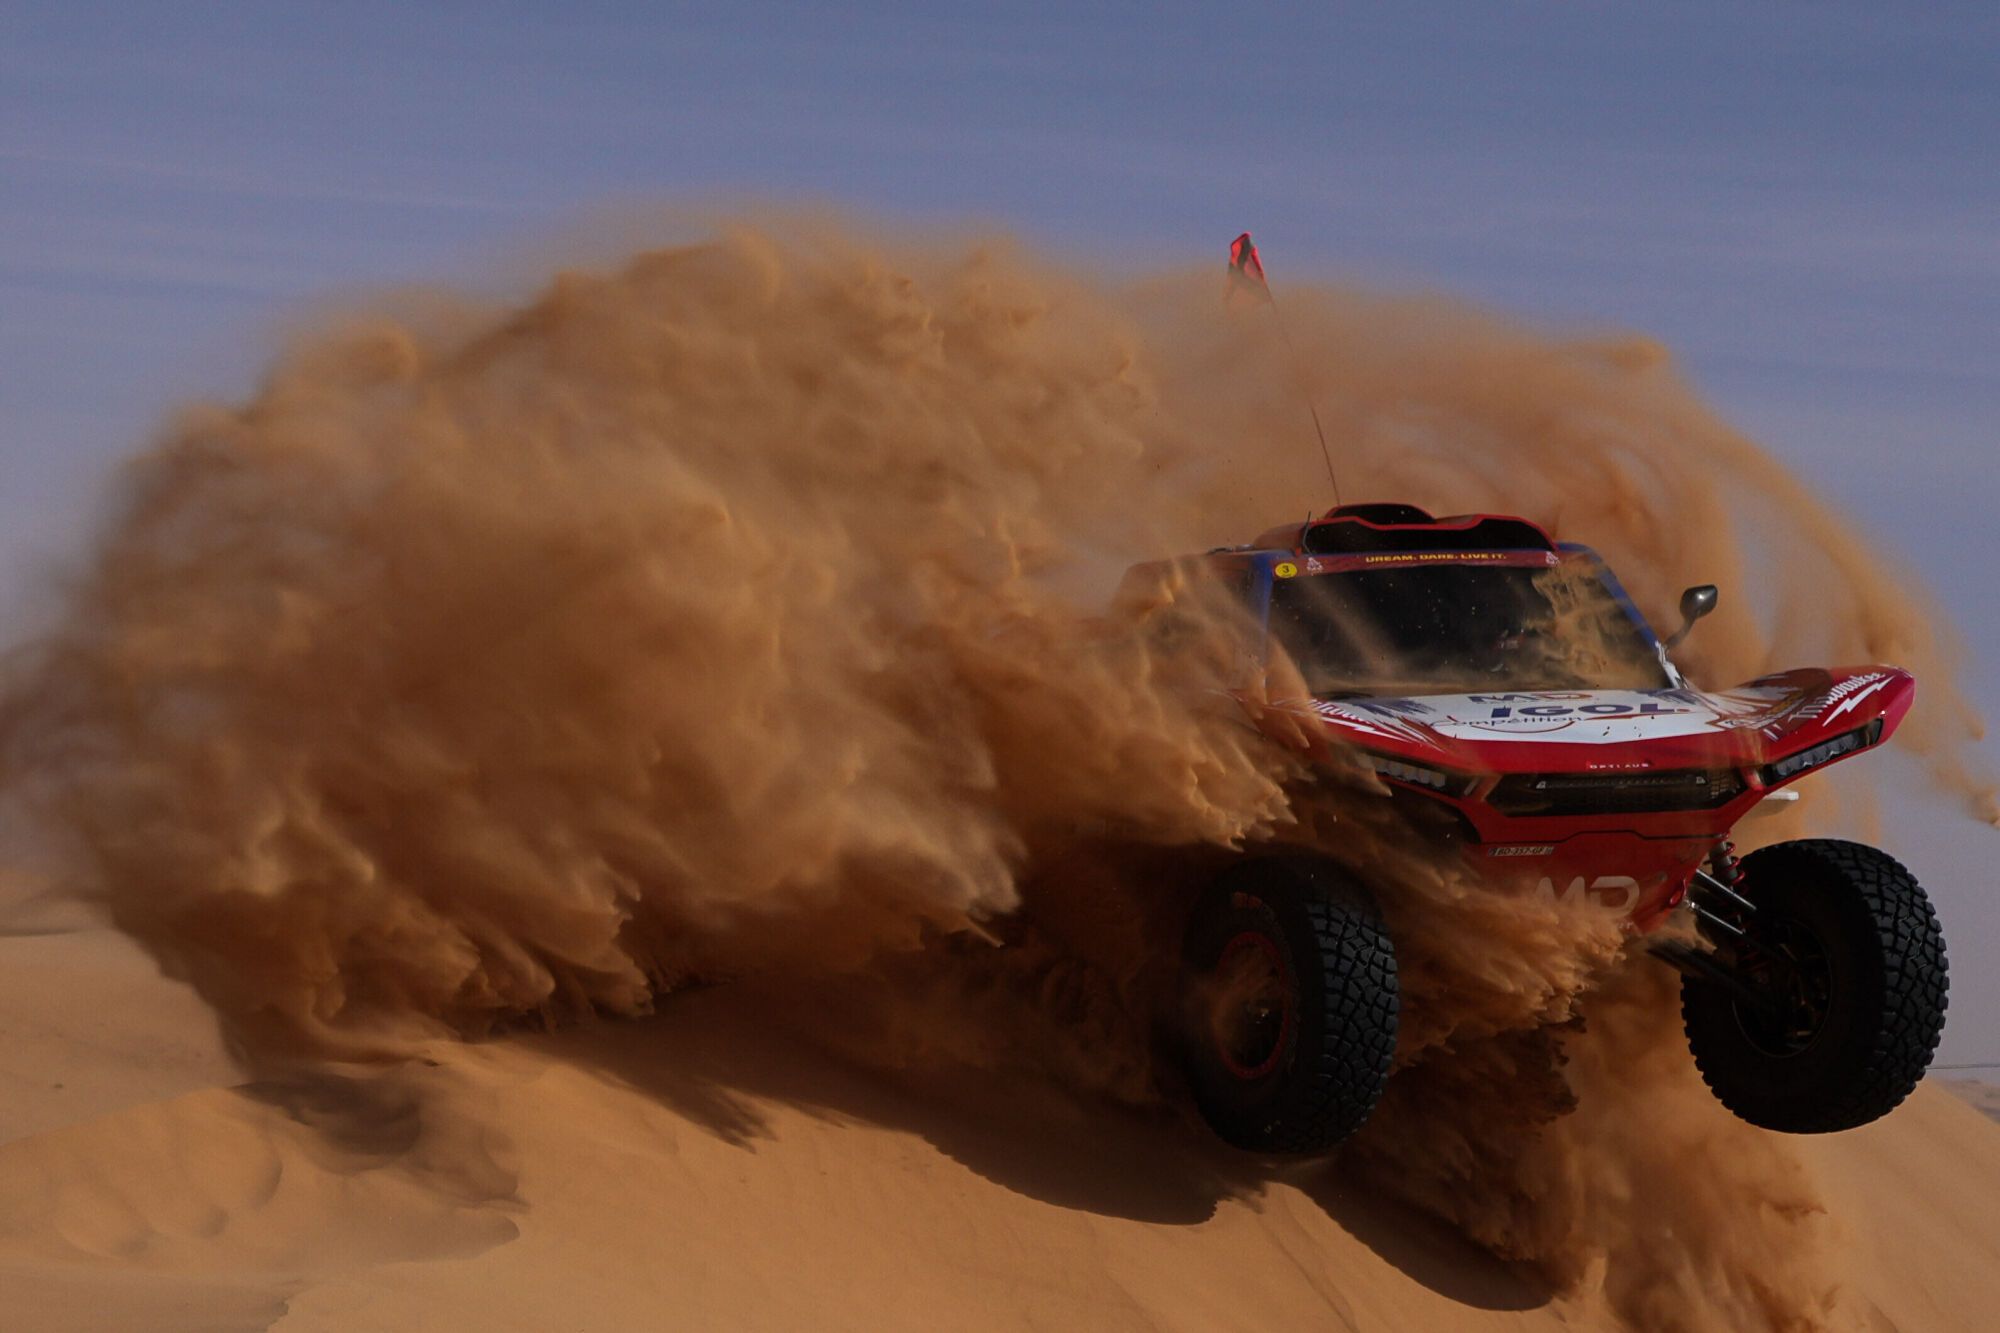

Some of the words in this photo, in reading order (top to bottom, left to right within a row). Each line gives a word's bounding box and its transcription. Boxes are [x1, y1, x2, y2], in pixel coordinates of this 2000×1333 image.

[1282, 565, 1290, 573] 3
[1491, 703, 1675, 718] IGOL
[1535, 875, 1640, 920] MD
